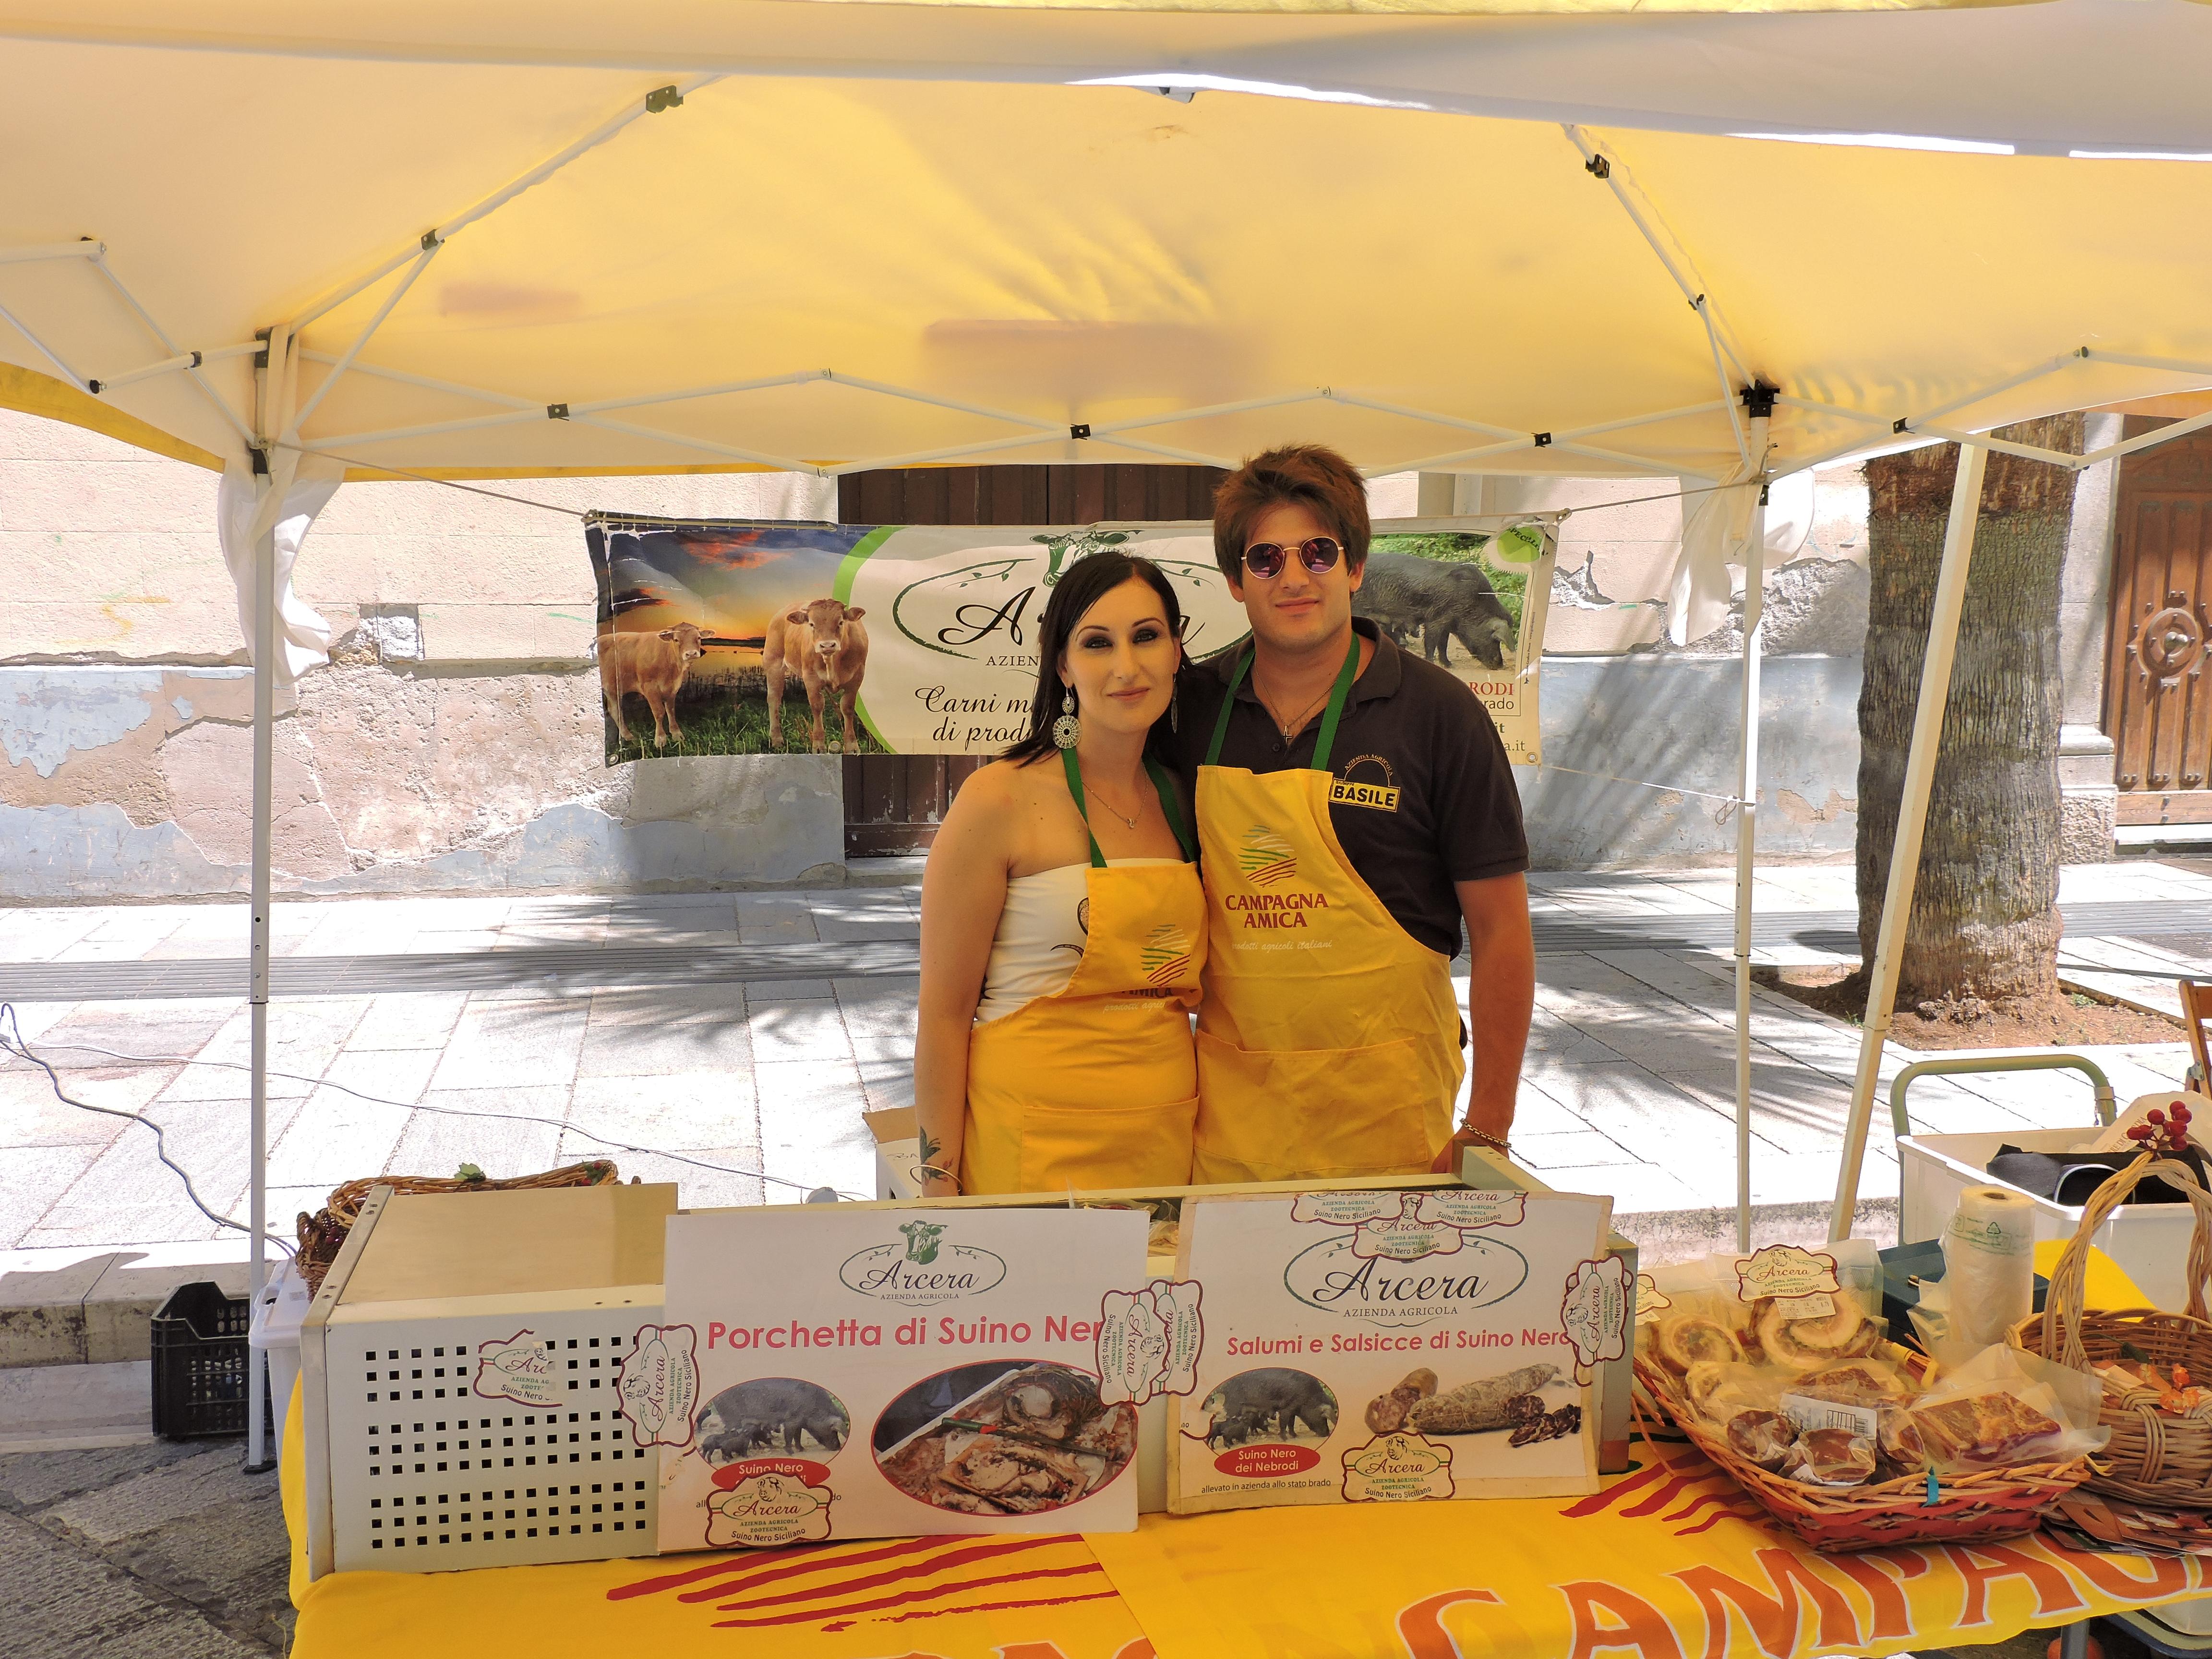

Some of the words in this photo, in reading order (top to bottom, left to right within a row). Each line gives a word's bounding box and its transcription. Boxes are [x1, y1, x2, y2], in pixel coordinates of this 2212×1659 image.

[985, 655, 1040, 666] AZIEN
[1469, 682, 1514, 696] RODI
[914, 685, 1001, 712] Carni
[1484, 697, 1515, 710] rado
[933, 716, 961, 741] di
[1345, 754, 1369, 770] AZIENDA
[1370, 754, 1394, 776] AGRICOLA
[1334, 785, 1396, 807] BASILE
[1225, 893, 1329, 911] CAMPAGNA
[1244, 912, 1308, 928] AMICA
[1232, 941, 1259, 950] rodotti
[1262, 940, 1294, 953] agricoli
[1297, 939, 1333, 950] italiani
[1314, 1209, 1332, 1218] Suino
[1352, 1209, 1381, 1219] Siciliano
[1436, 1211, 1455, 1221] Suino
[1473, 1214, 1502, 1223] Siciliano
[1375, 1244, 1393, 1253] Suino
[1412, 1242, 1440, 1253] Siciliano
[859, 1259, 980, 1290] Arcera
[1312, 1257, 1489, 1302] Arcera
[1756, 1265, 1810, 1281] Arcera
[1795, 1284, 1820, 1293] Siciliano
[1188, 1303, 1197, 1334] Siciliano
[1344, 1308, 1396, 1317] AZIENDA
[1400, 1306, 1458, 1316] AGRICOLA
[1586, 1286, 1600, 1342] Arcera
[708, 1319, 882, 1349] Porchetta
[894, 1317, 926, 1345] di
[938, 1316, 1032, 1344] Suino
[1045, 1316, 1104, 1342] Ner
[1105, 1314, 1116, 1334] Suino
[1611, 1320, 1620, 1339] Suino
[1102, 1335, 1111, 1353] Nero
[1127, 1314, 1143, 1377] Arcera
[1188, 1334, 1196, 1352] Nero
[1227, 1334, 1302, 1356] Salumi
[1310, 1339, 1323, 1353] e
[1331, 1333, 1422, 1353] Salsicce
[1430, 1330, 1450, 1349] di
[1456, 1329, 1514, 1348] Suino
[1521, 1328, 1572, 1346] Nero
[681, 1349, 692, 1380] Siciliano
[1102, 1353, 1112, 1384] Siciliano
[1182, 1353, 1194, 1372] Suino
[501, 1384, 522, 1396] Suino
[524, 1391, 543, 1401] Nero
[647, 1355, 665, 1422] Arcera
[683, 1382, 692, 1400] Nero
[677, 1402, 689, 1422] Suino
[1238, 1450, 1267, 1460] Suino
[1271, 1449, 1296, 1458] Nero
[738, 1464, 770, 1475] Suino
[775, 1463, 804, 1472] Nero
[1235, 1463, 1252, 1473] dei
[1255, 1460, 1299, 1472] Nebrodi
[1365, 1458, 1425, 1474] Arcera
[1202, 1484, 1230, 1494] allevato
[1241, 1481, 1270, 1490] azienda
[1272, 1480, 1286, 1488] allo
[1308, 1478, 1331, 1487] brado
[1365, 1487, 1384, 1498] Suino
[1404, 1486, 1431, 1498] Siciliano
[733, 1500, 802, 1517] Arcera
[731, 1531, 752, 1541] Suino
[774, 1528, 806, 1541] Siciliano
